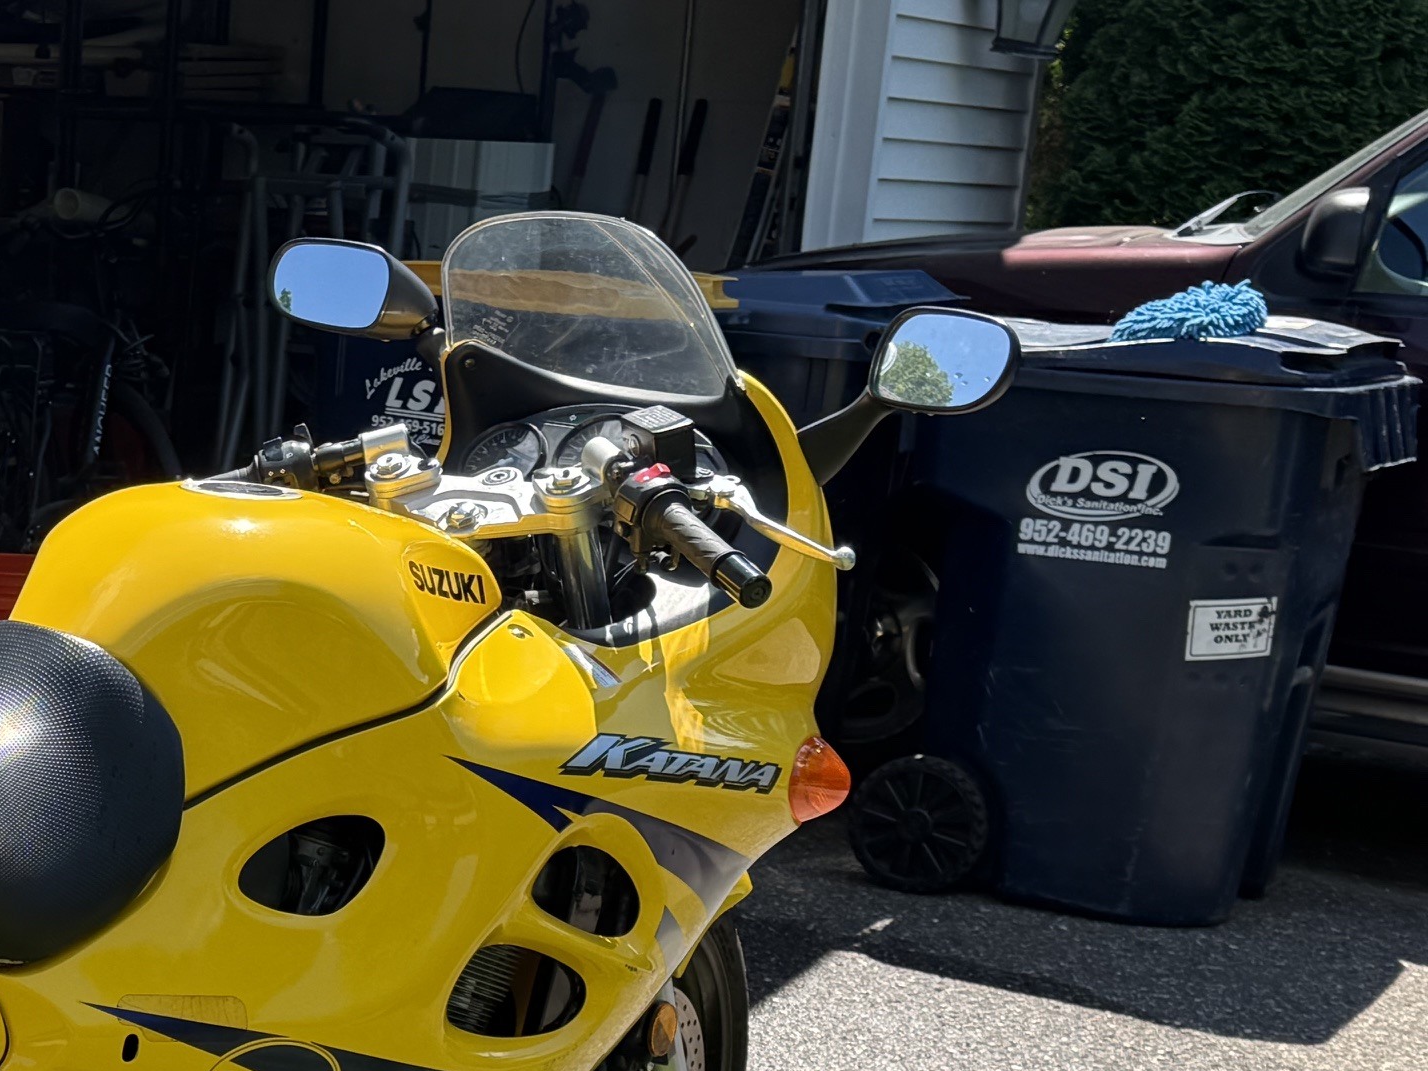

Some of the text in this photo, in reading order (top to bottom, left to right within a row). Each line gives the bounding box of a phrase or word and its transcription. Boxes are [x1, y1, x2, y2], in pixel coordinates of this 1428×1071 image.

[365, 356, 422, 400] Lakeville
[1049, 456, 1158, 500] DSI
[1019, 517, 1172, 554] 952-469-2239
[1017, 542, 1168, 569] www.dickssanitation.com
[408, 560, 486, 605] SUZUKI
[1210, 621, 1256, 632] WASTE
[1215, 608, 1253, 619] YARD
[1213, 633, 1250, 644] ONLY
